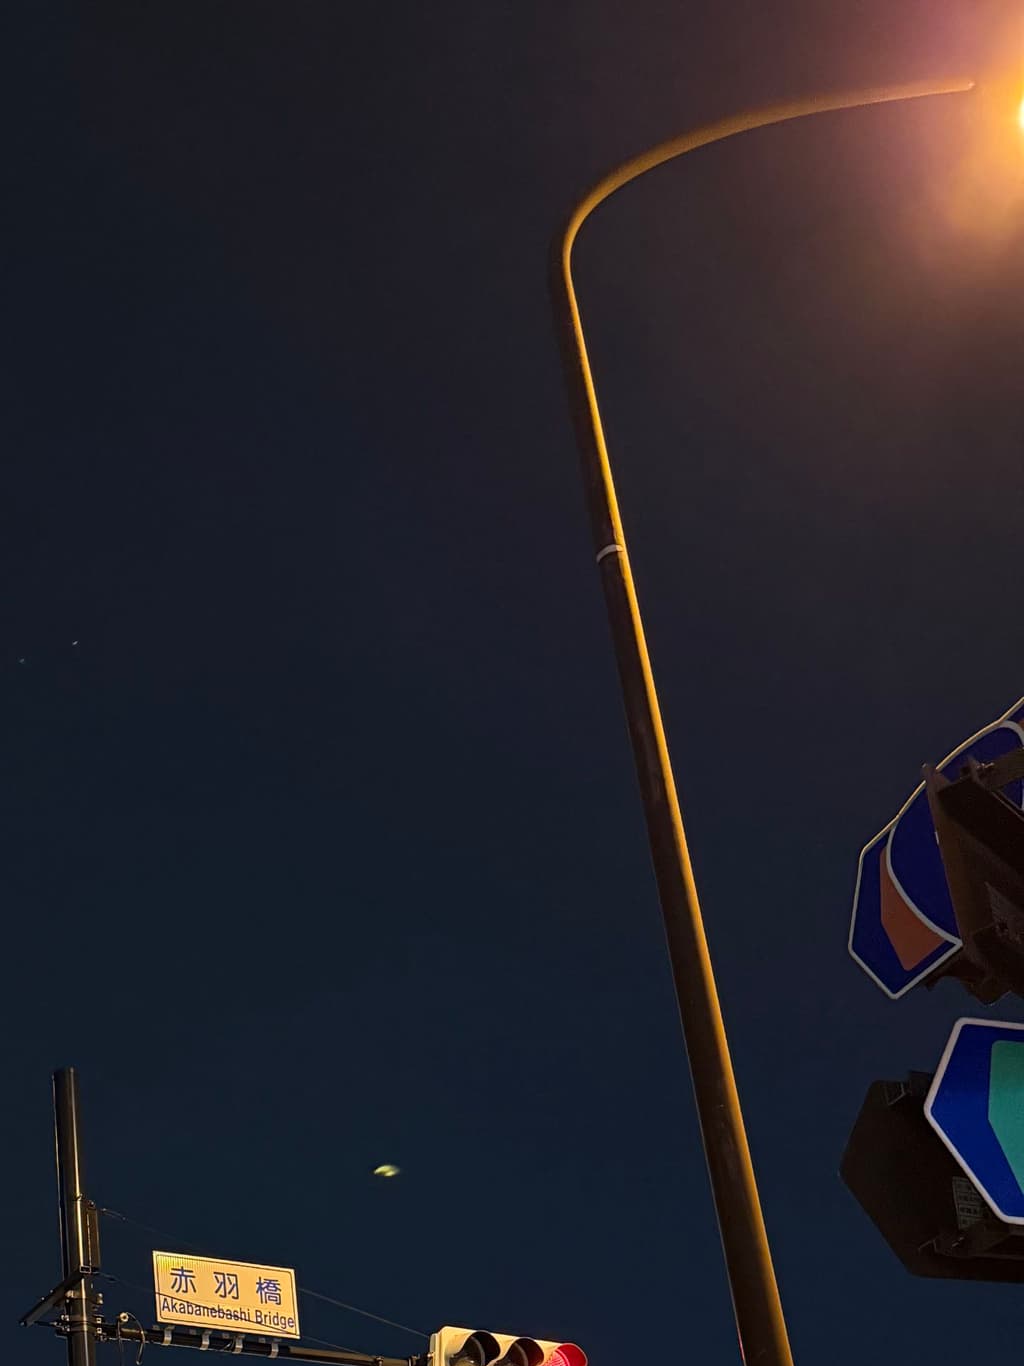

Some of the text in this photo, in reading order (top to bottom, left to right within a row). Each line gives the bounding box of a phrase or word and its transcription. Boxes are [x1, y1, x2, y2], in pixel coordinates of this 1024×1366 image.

[170, 1266, 282, 1306] 赤羽橋
[161, 1297, 295, 1330] Akabanebashi Bridge
